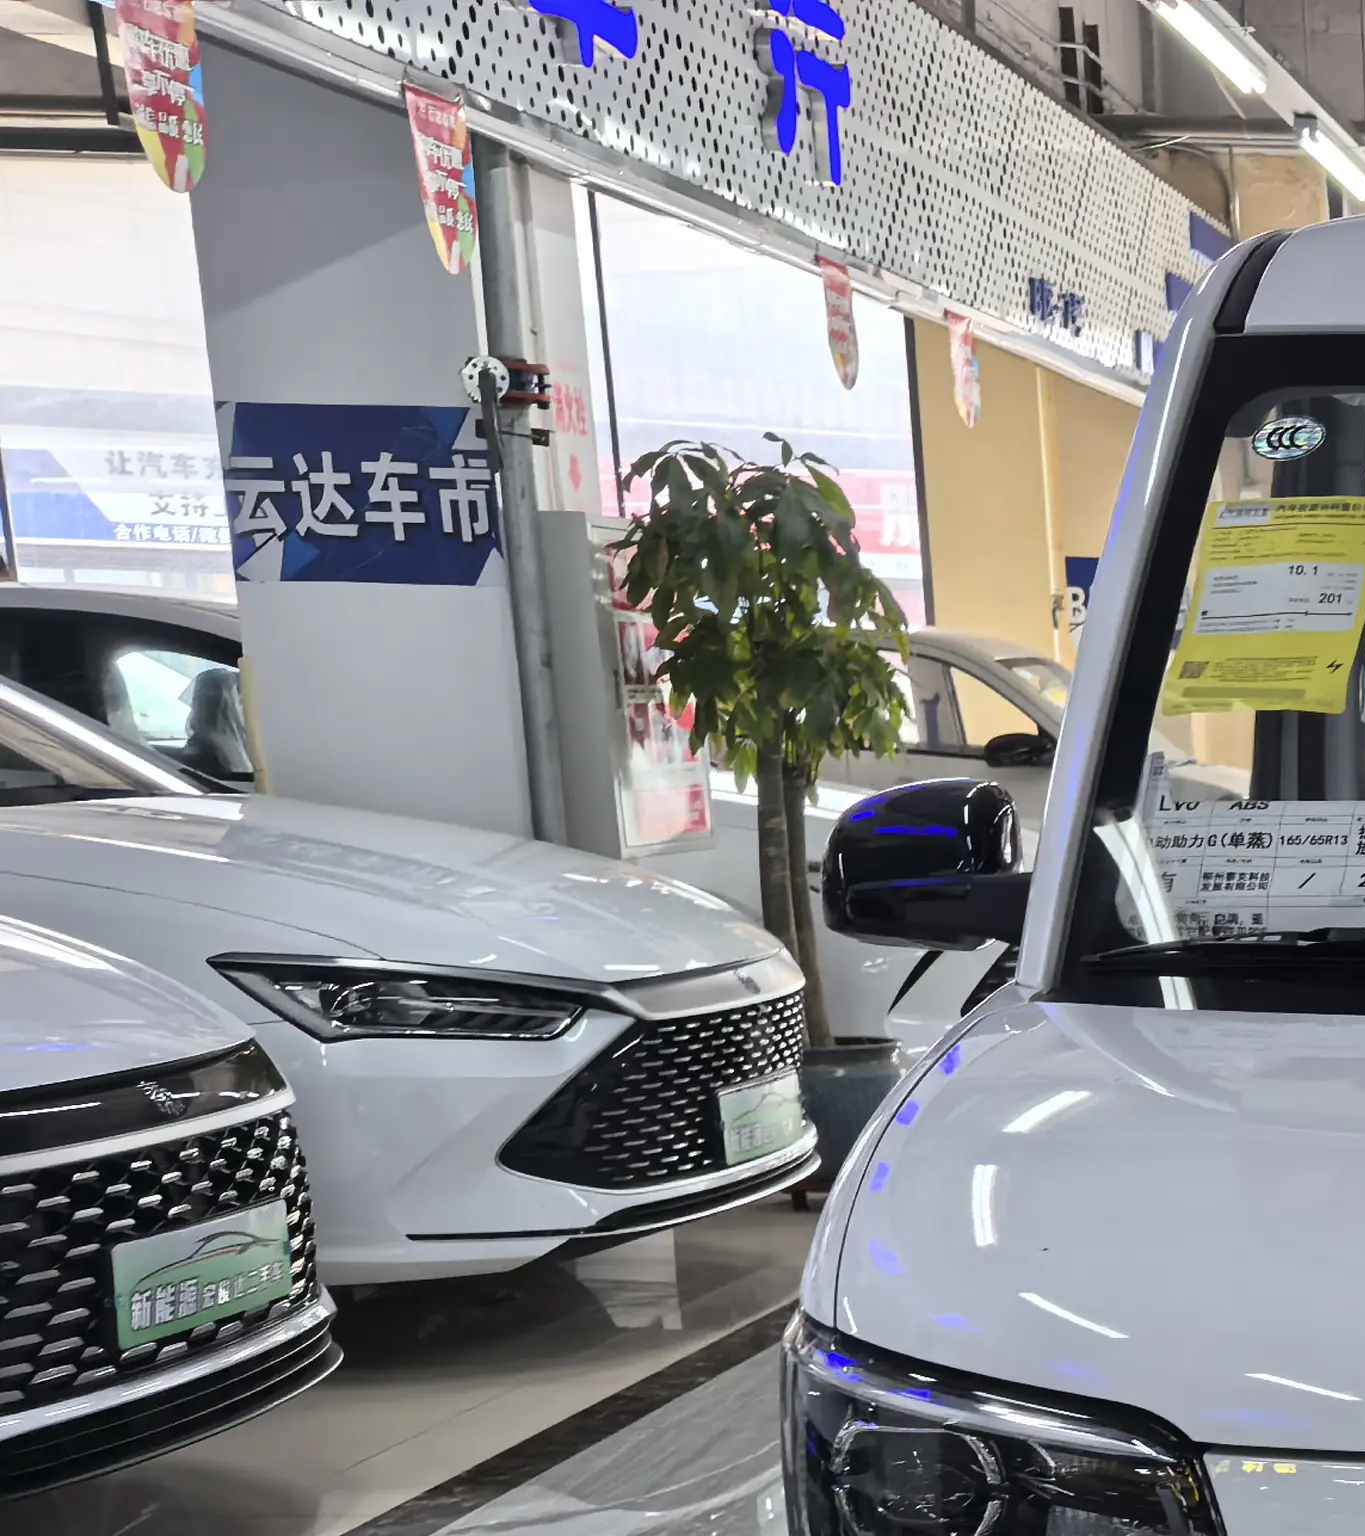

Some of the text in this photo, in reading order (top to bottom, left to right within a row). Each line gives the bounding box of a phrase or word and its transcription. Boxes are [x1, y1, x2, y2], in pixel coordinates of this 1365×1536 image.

[1266, 424, 1308, 451] CCC
[226, 450, 495, 544] 云达车市
[1318, 593, 1343, 604] 201
[1152, 832, 1204, 850] 动助力
[1278, 834, 1349, 847] 165/65R13
[130, 1276, 200, 1331] 新能源
